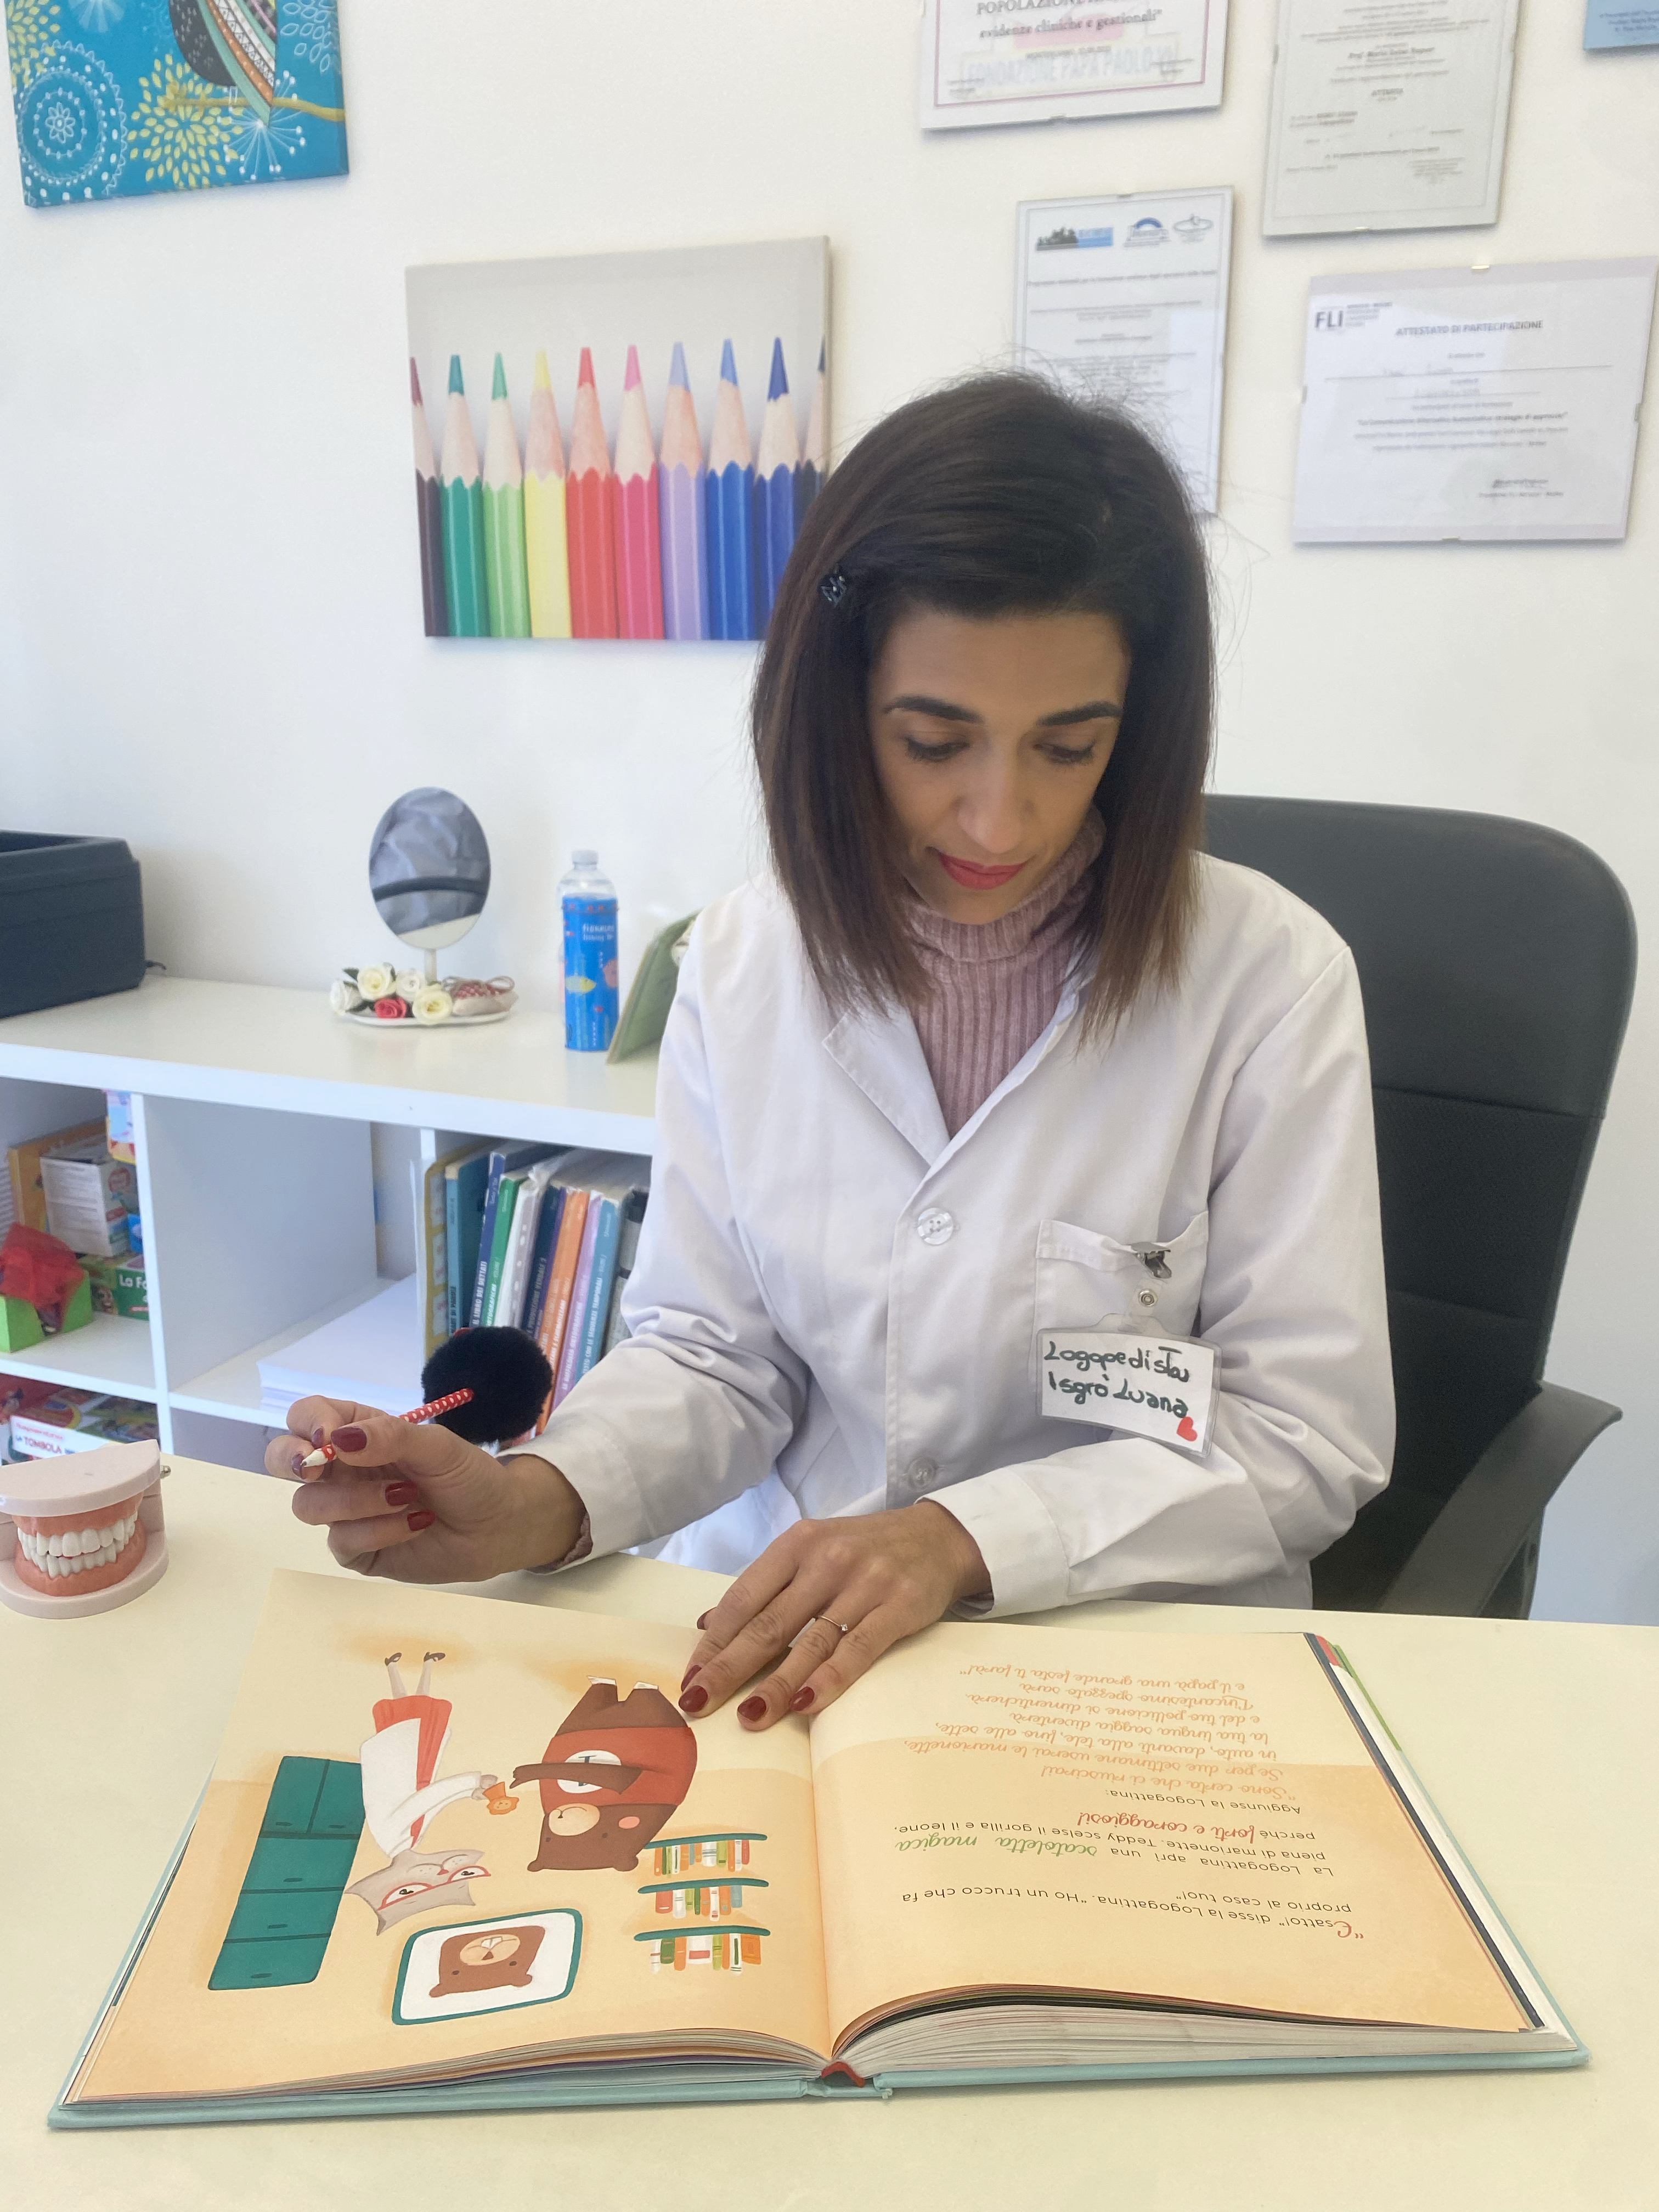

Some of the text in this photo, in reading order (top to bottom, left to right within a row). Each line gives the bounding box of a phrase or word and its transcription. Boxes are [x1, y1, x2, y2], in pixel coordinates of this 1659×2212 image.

[1314, 310, 1344, 329] FLI
[1395, 320, 1544, 336] ATTESTATO DI PARTECIPAZIONE
[477, 1261, 487, 1286] DETTATI
[119, 1274, 133, 1288] La
[473, 1298, 482, 1318] LIBRO
[1044, 1340, 1190, 1383] Logopedista
[1048, 1372, 1189, 1419] Isgrò Luana
[24, 1436, 63, 1454] TOMBOLA
[1015, 1669, 1025, 1679] ti
[1031, 1670, 1070, 1683] festa
[1074, 1675, 1132, 1685] grande
[1019, 1684, 1060, 1694] sarà
[1175, 1679, 1218, 1691] papà
[1220, 1683, 1231, 1694] il
[1066, 1688, 1133, 1701] spezzato
[1086, 1706, 1100, 1715] si
[1105, 1707, 1186, 1723] pollicione
[1189, 1714, 1215, 1726] tuo
[1220, 1716, 1245, 1726] del
[1009, 1713, 1268, 1745] la tua lingua saggia diventerà
[935, 1723, 1276, 1761] in auto, davanti alla tele, fino alle sette,
[905, 1741, 1283, 1780] Se per due settimane userai le marionette,
[1041, 1766, 1125, 1781] riuscirai!
[1130, 1776, 1146, 1786] ci
[1152, 1778, 1181, 1791] che
[1187, 1781, 1233, 1794] certa
[1105, 1790, 1300, 1814] Aggiunse la Logogattina:
[952, 1822, 960, 1831] il
[980, 1822, 1032, 1832] gorilla
[1038, 1827, 1046, 1835] il
[1077, 1813, 1316, 1844] perché forti e coraggiosi!
[1052, 1828, 1101, 1839] scelse
[1108, 1833, 1157, 1847] Teddy
[895, 1832, 977, 1851] magica
[995, 1837, 1097, 1857] scatoletta
[1161, 1840, 1256, 1855] marionette.
[1110, 1848, 1141, 1857] una
[1261, 1850, 1276, 1859] di
[1281, 1852, 1325, 1861] piena
[1200, 1858, 1301, 1875] Logogattina
[1313, 1867, 1334, 1876] La
[902, 1893, 918, 1903] fa
[924, 1888, 955, 1898] che
[962, 1887, 1020, 1897] trucco
[1055, 1892, 1087, 1903] “Ho
[1092, 1895, 1203, 1917] Logogattina.
[1223, 1896, 1260, 1906] caso
[1267, 1900, 1280, 1909] al
[1288, 1902, 1351, 1912] proprio
[1208, 1909, 1223, 1920] la
[1228, 1911, 1270, 1924] disse
